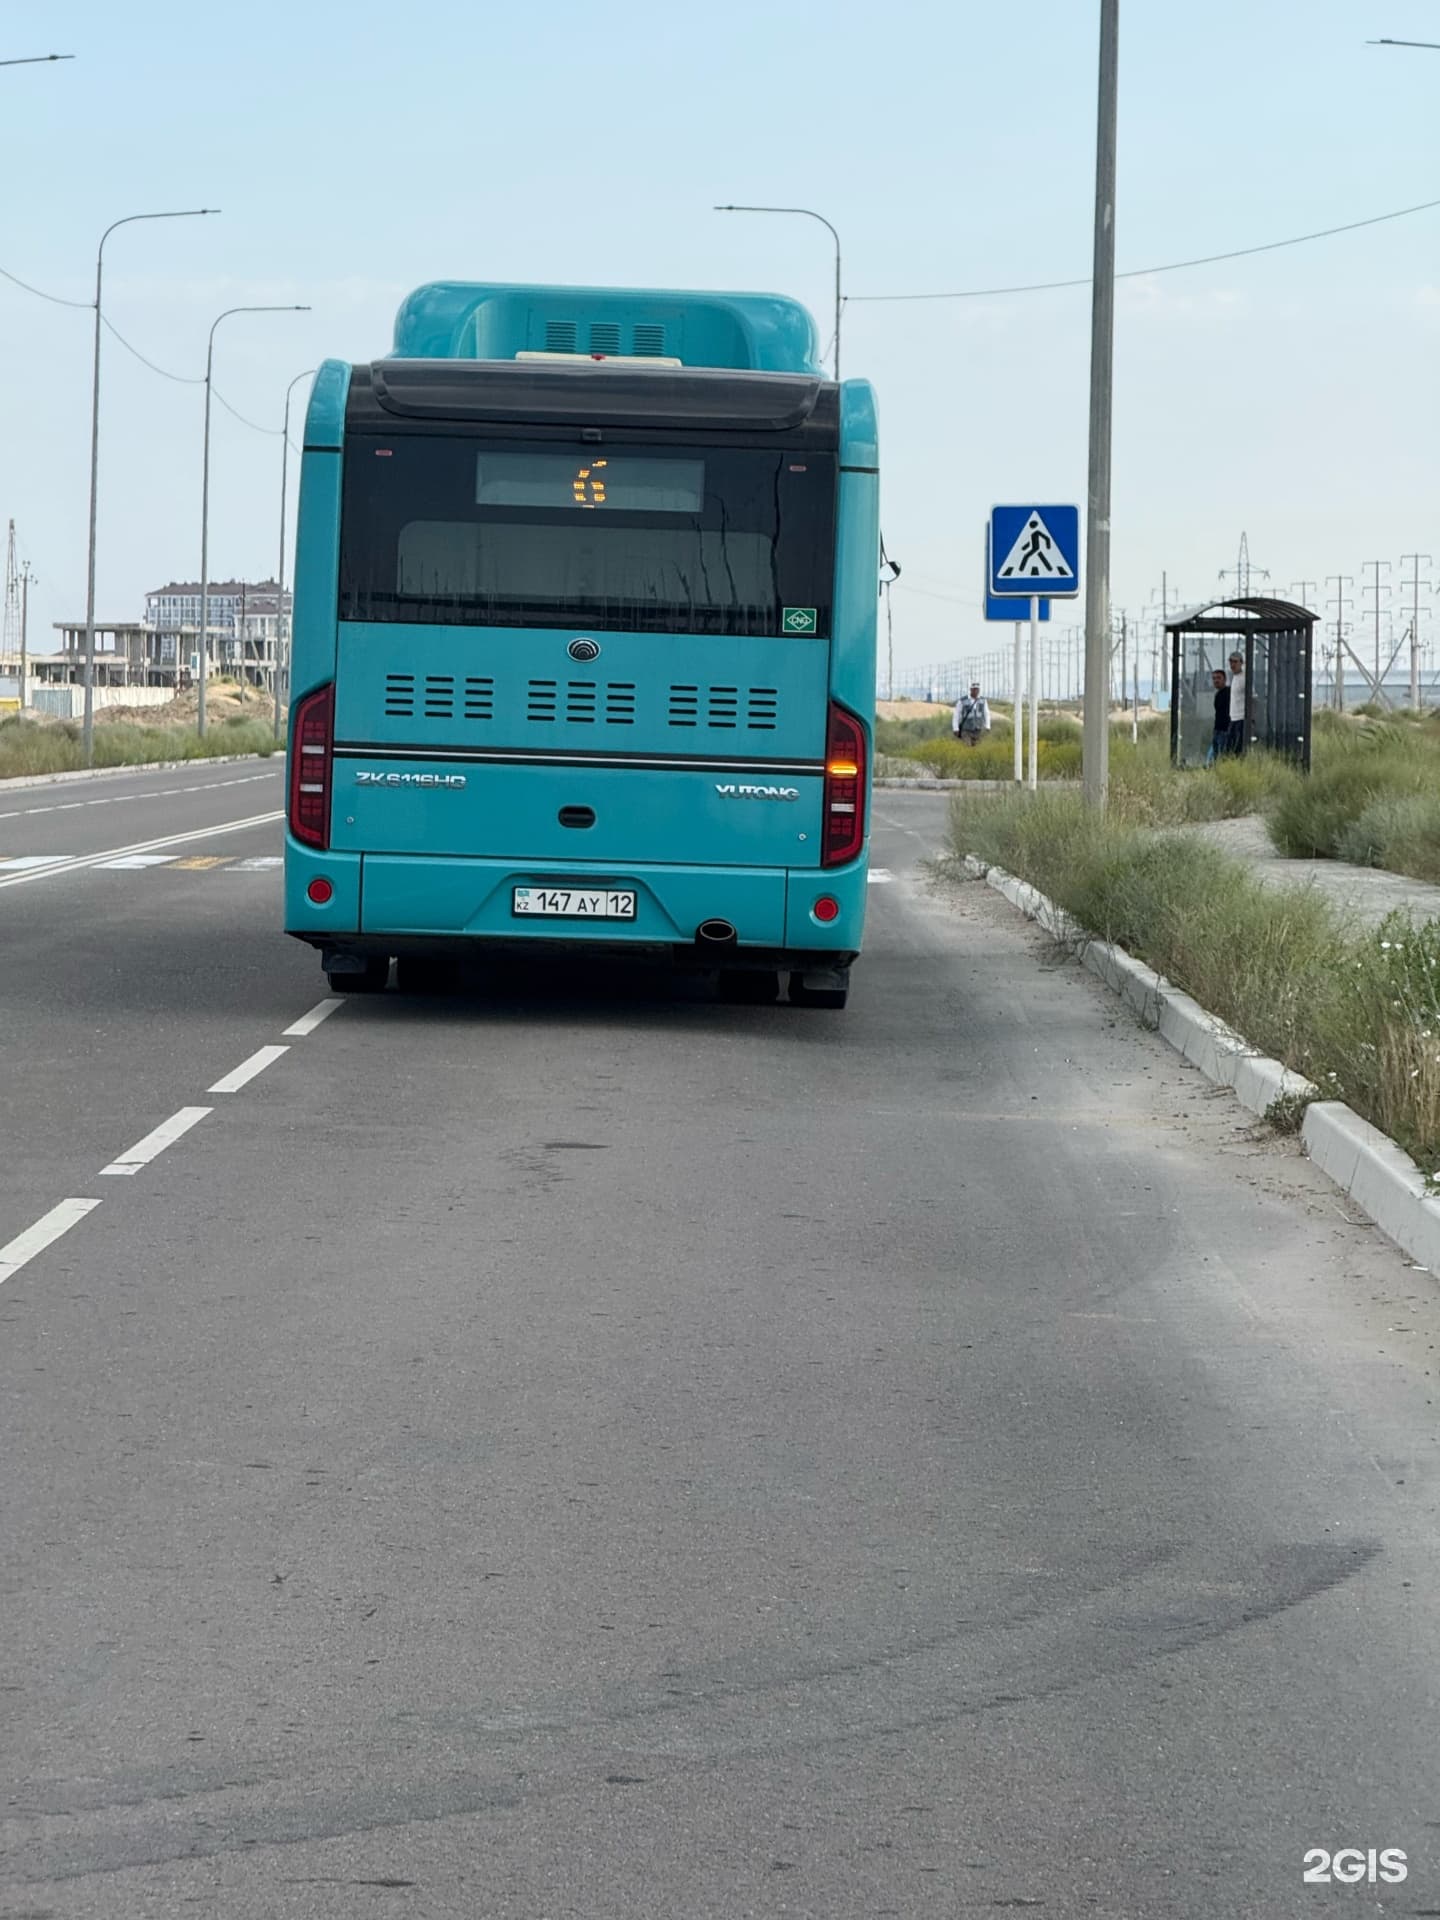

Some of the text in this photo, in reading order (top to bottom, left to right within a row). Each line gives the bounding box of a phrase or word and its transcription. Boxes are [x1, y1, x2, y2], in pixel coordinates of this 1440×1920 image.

[573, 460, 607, 508] 6
[715, 784, 800, 801] YUTONG
[516, 901, 529, 910] KZ
[537, 891, 633, 914] 147 AY 12
